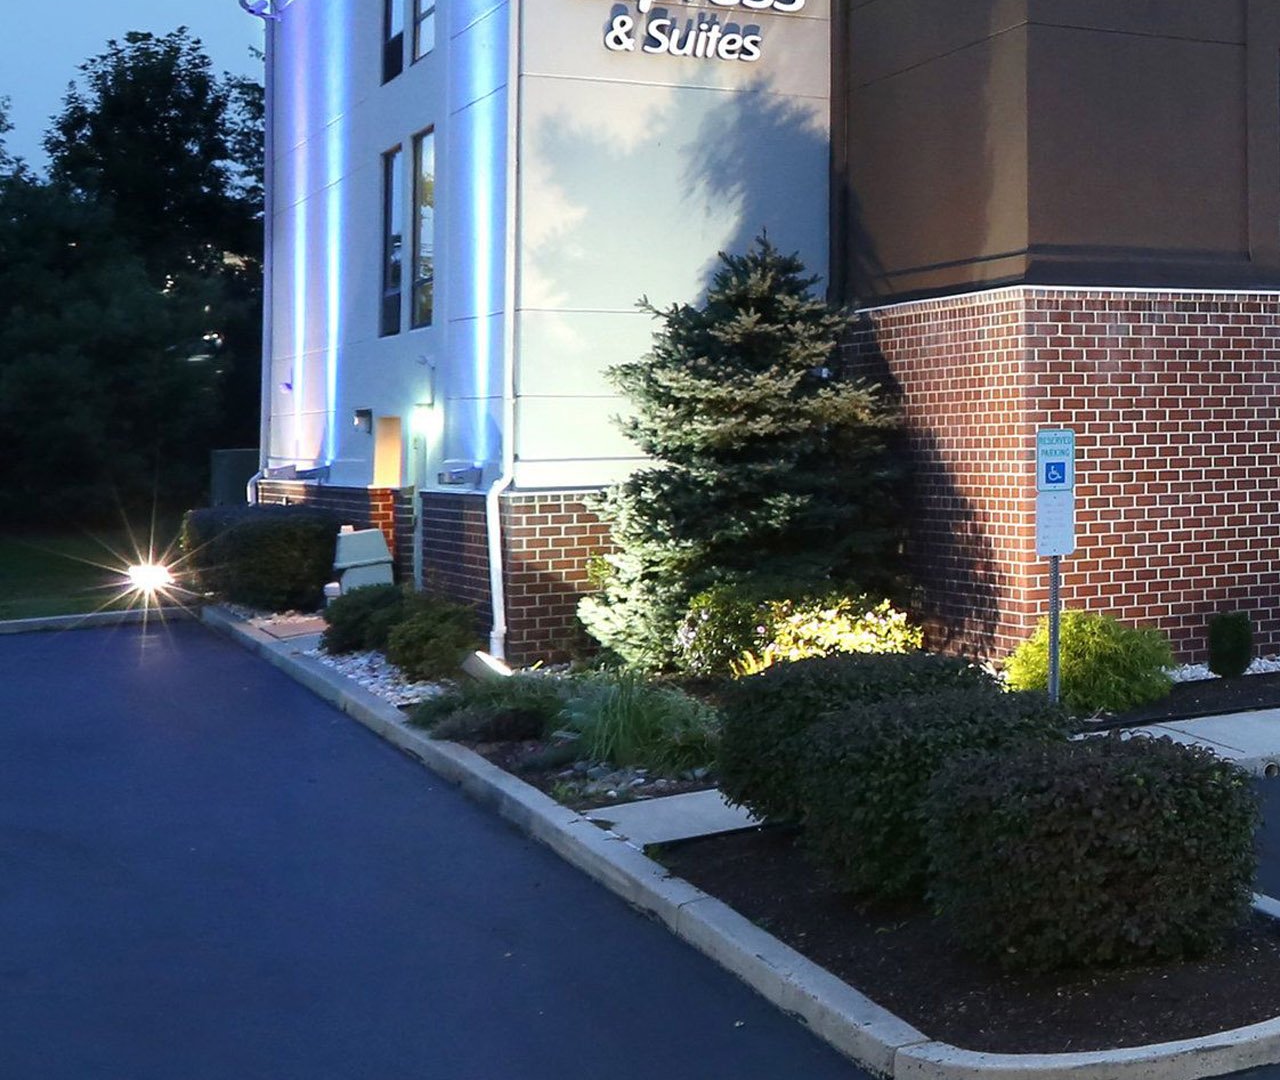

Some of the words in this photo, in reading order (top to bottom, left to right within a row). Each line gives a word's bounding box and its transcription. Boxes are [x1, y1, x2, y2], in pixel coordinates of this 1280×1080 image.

[604, 15, 634, 51] &
[644, 19, 762, 61] Suites
[1038, 436, 1072, 445] RESERVED
[1040, 448, 1070, 457] PARKING
